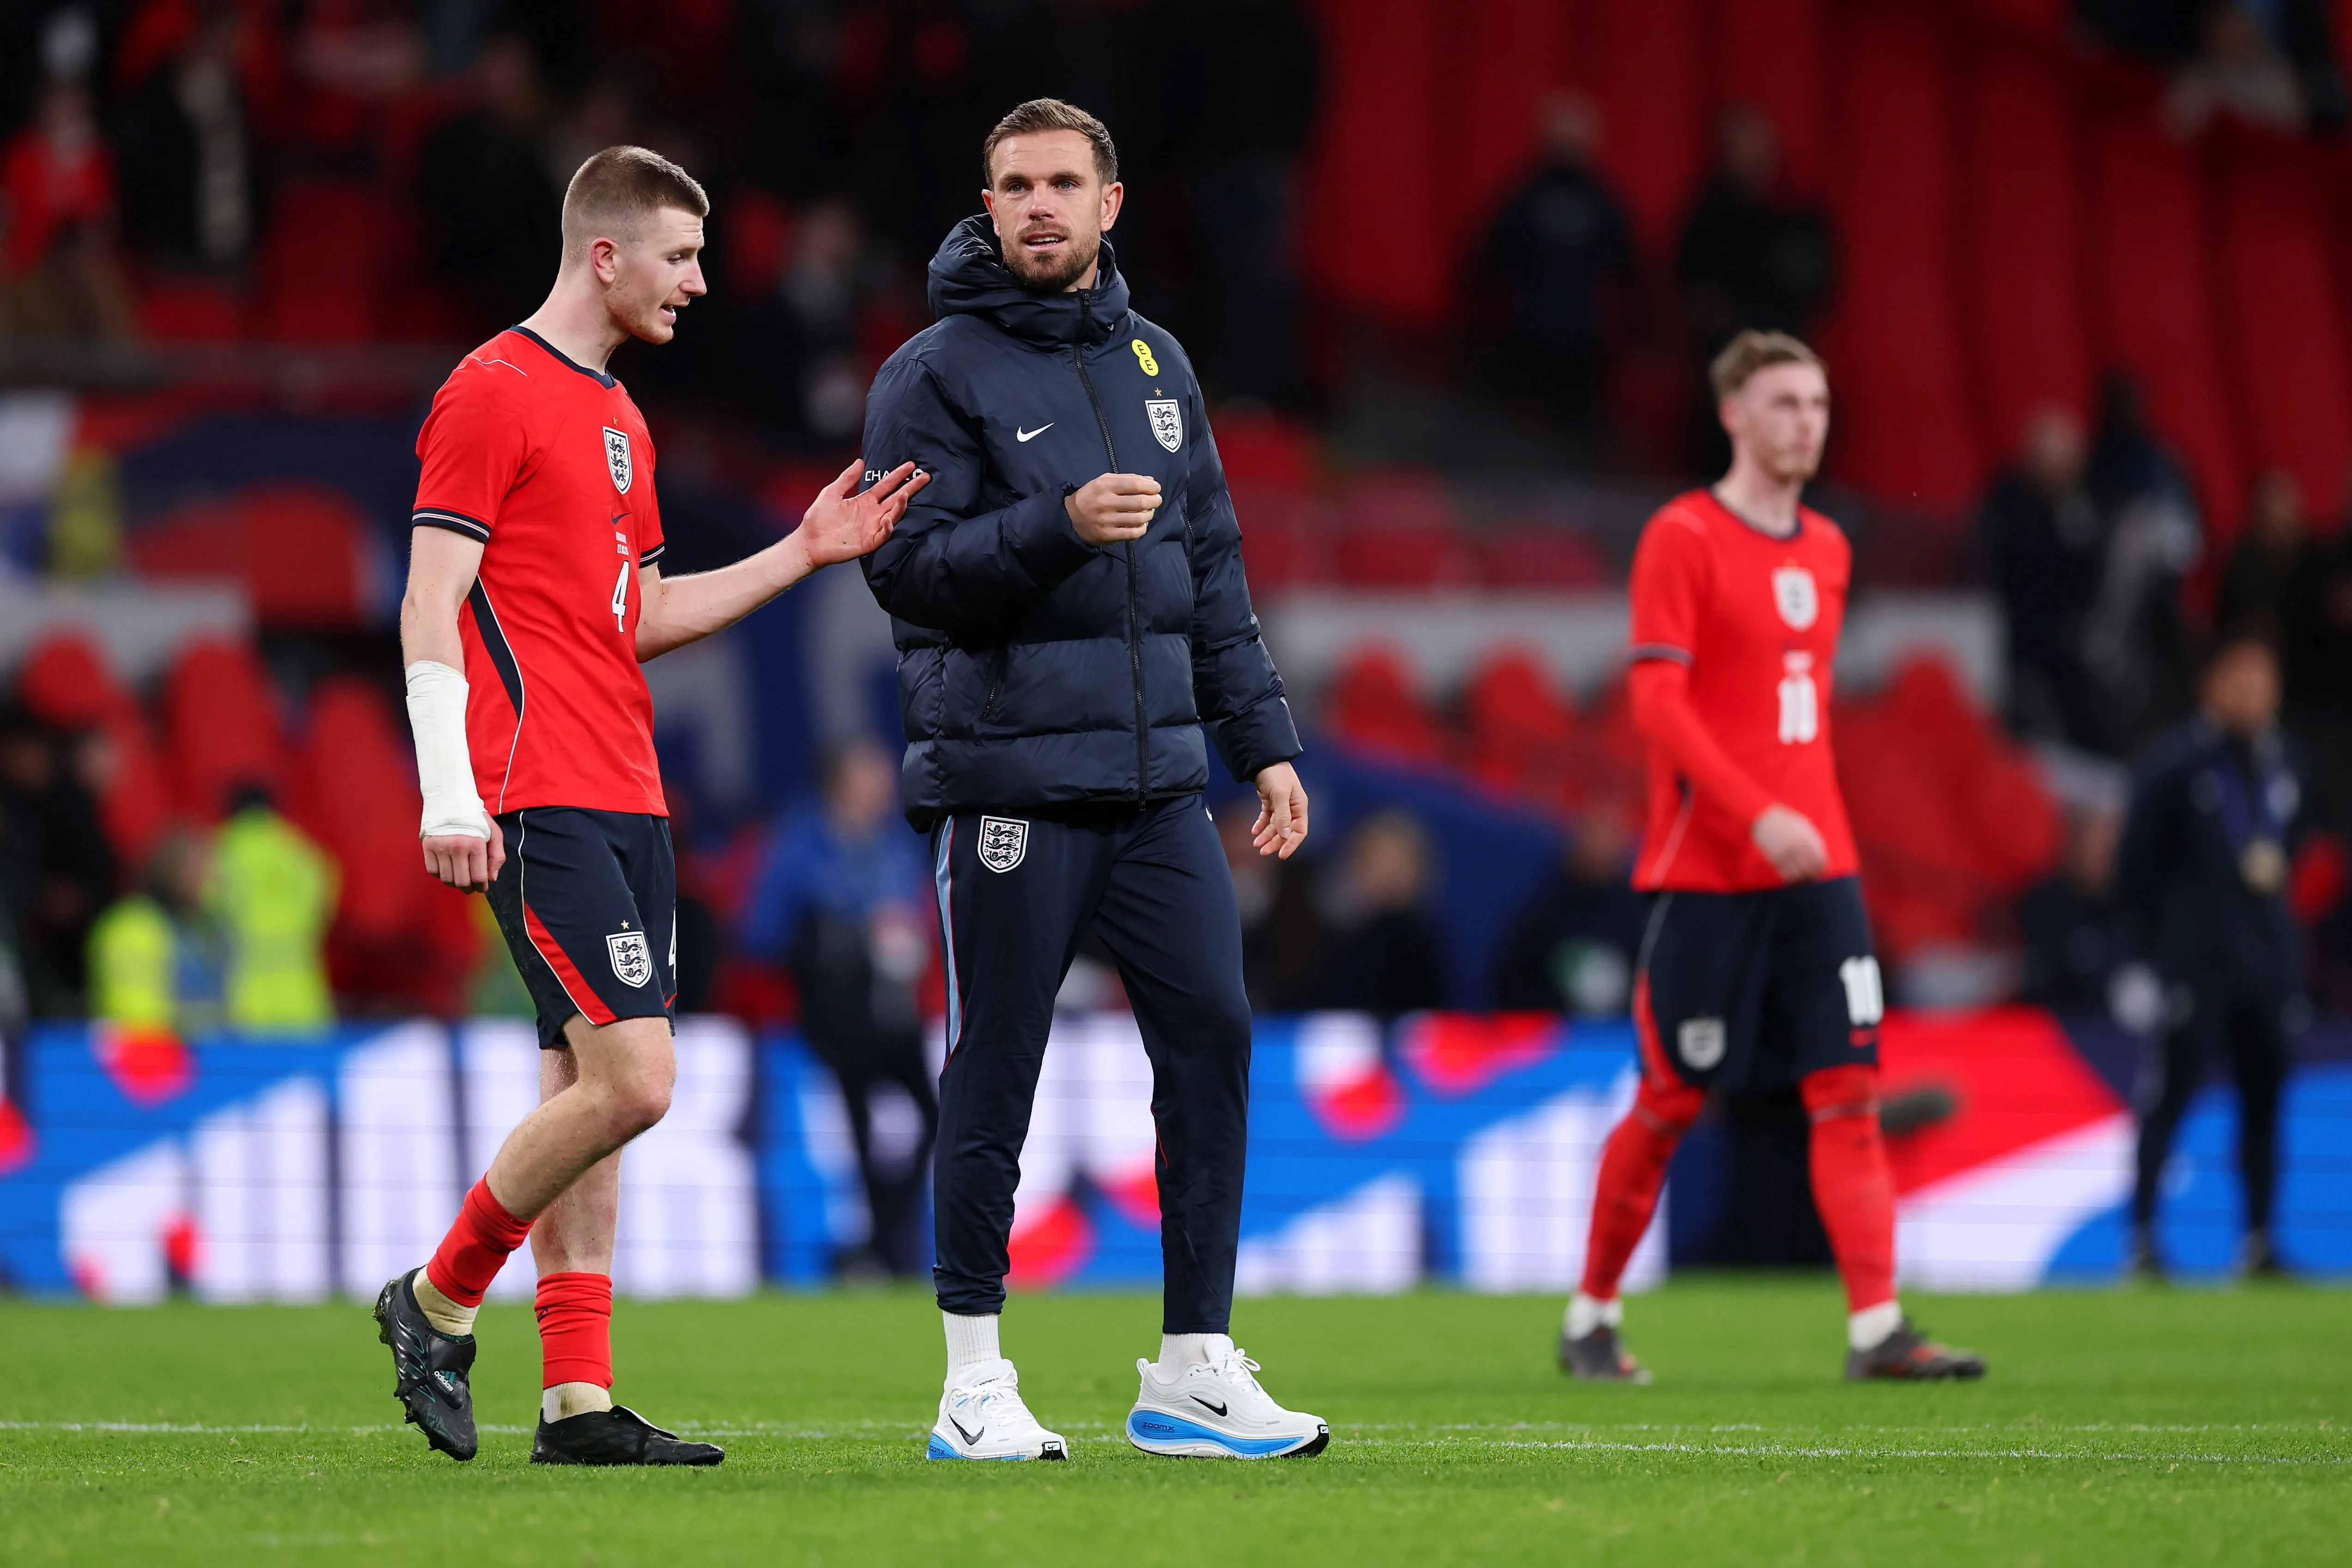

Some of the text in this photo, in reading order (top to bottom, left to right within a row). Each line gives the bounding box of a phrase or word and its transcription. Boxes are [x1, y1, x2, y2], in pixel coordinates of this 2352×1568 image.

[612, 560, 630, 634] 4
[1777, 675, 1819, 745] 10
[434, 1370, 454, 1392] adidas
